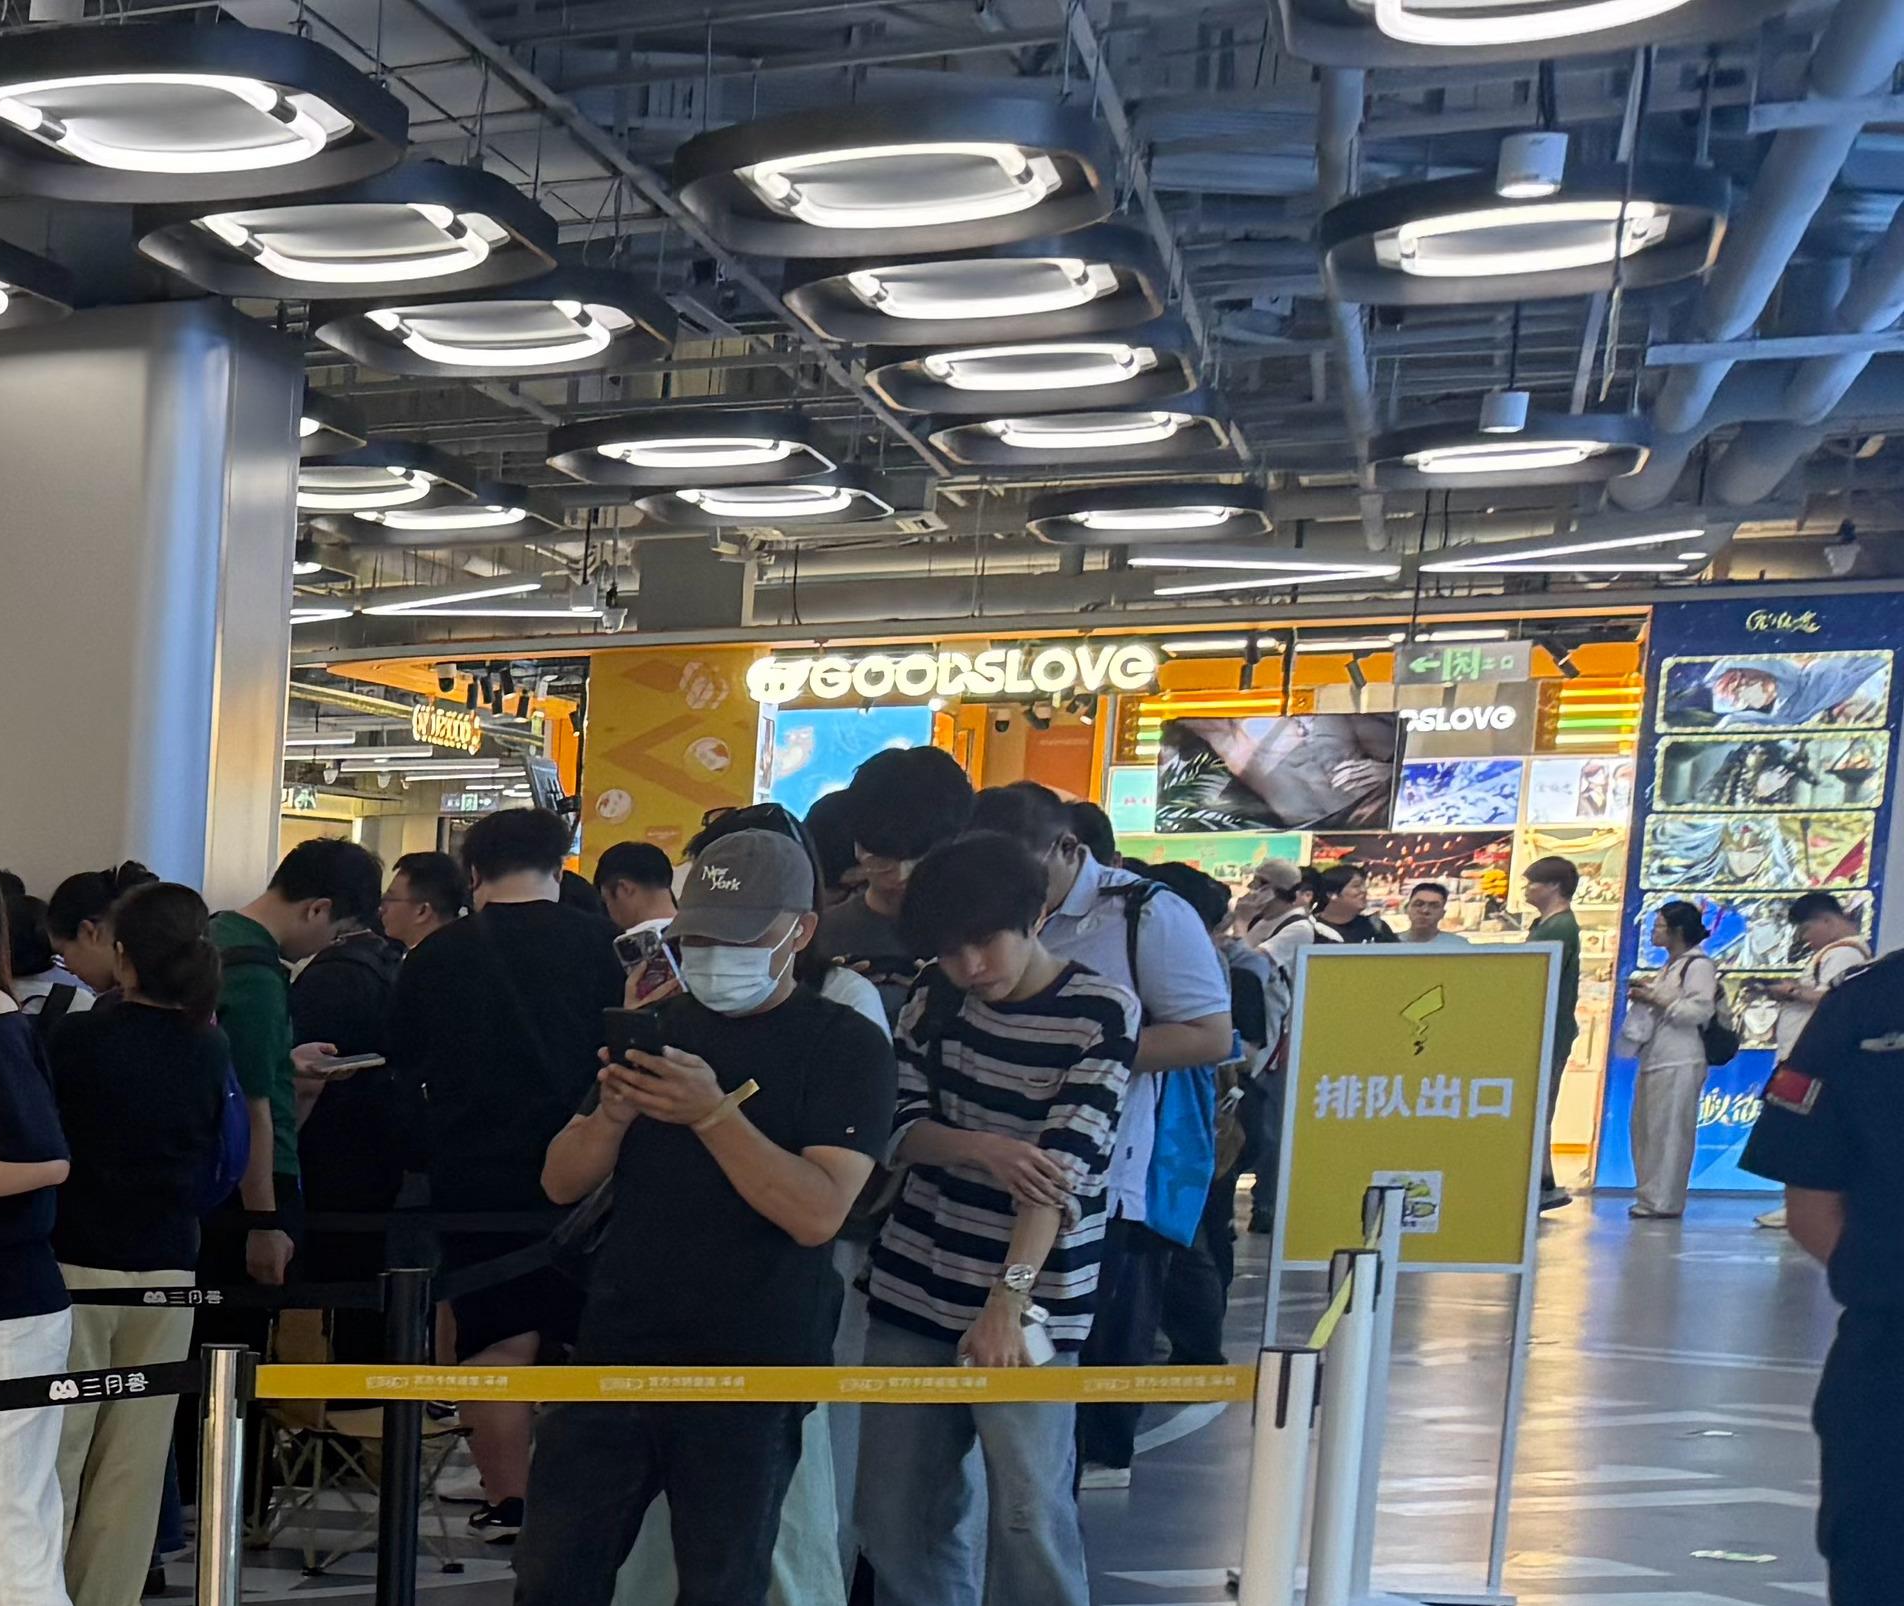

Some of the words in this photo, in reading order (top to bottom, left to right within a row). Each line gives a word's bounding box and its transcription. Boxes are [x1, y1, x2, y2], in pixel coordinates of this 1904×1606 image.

[1315, 1074, 1513, 1118] 排队出口
[82, 1372, 149, 1396] 三月兽
